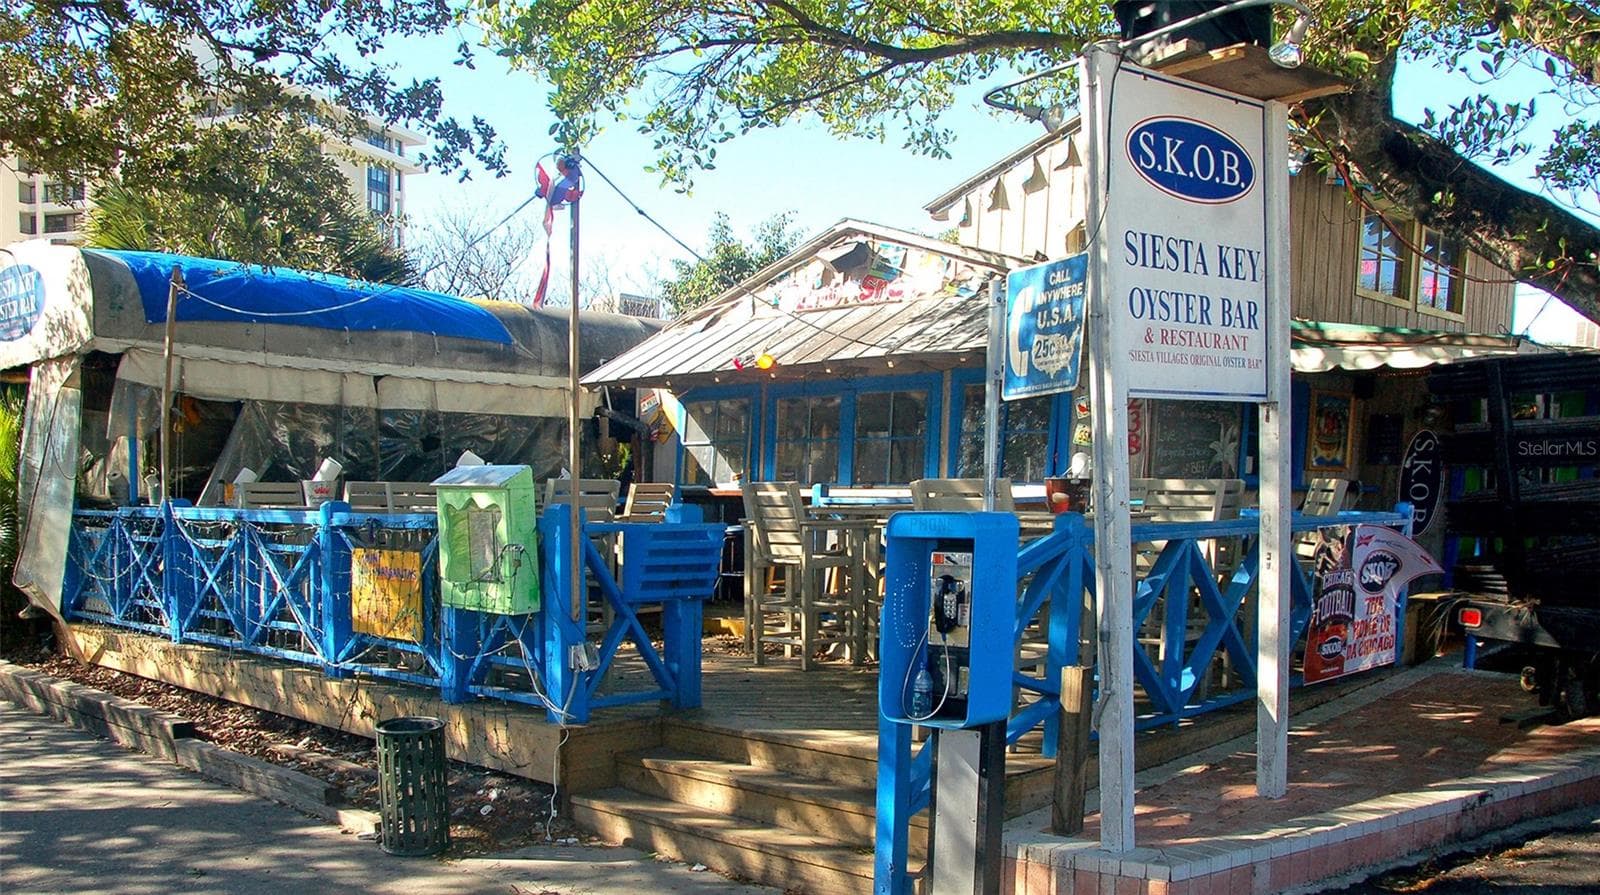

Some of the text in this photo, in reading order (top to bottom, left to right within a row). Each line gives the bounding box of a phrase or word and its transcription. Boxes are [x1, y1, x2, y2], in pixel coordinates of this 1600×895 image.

[1139, 131, 1246, 189] S.K.O.B.
[1124, 230, 1261, 283] SIESTA KEY
[1049, 271, 1071, 286] CALL
[1039, 282, 1085, 306] ANYWHERE
[1037, 304, 1076, 330] U.S.A.
[1128, 286, 1260, 330] OYSTER BAR
[1144, 327, 1249, 351] & RESTAURANT
[1155, 352, 1189, 366] VILLAGES
[1190, 354, 1222, 368] ORIGINAL
[1222, 357, 1247, 369] OYSTER
[1315, 590, 1353, 624] FOOTBALL
[1352, 614, 1391, 641] HOME OF
[1346, 634, 1395, 660] DA CHICAGO
